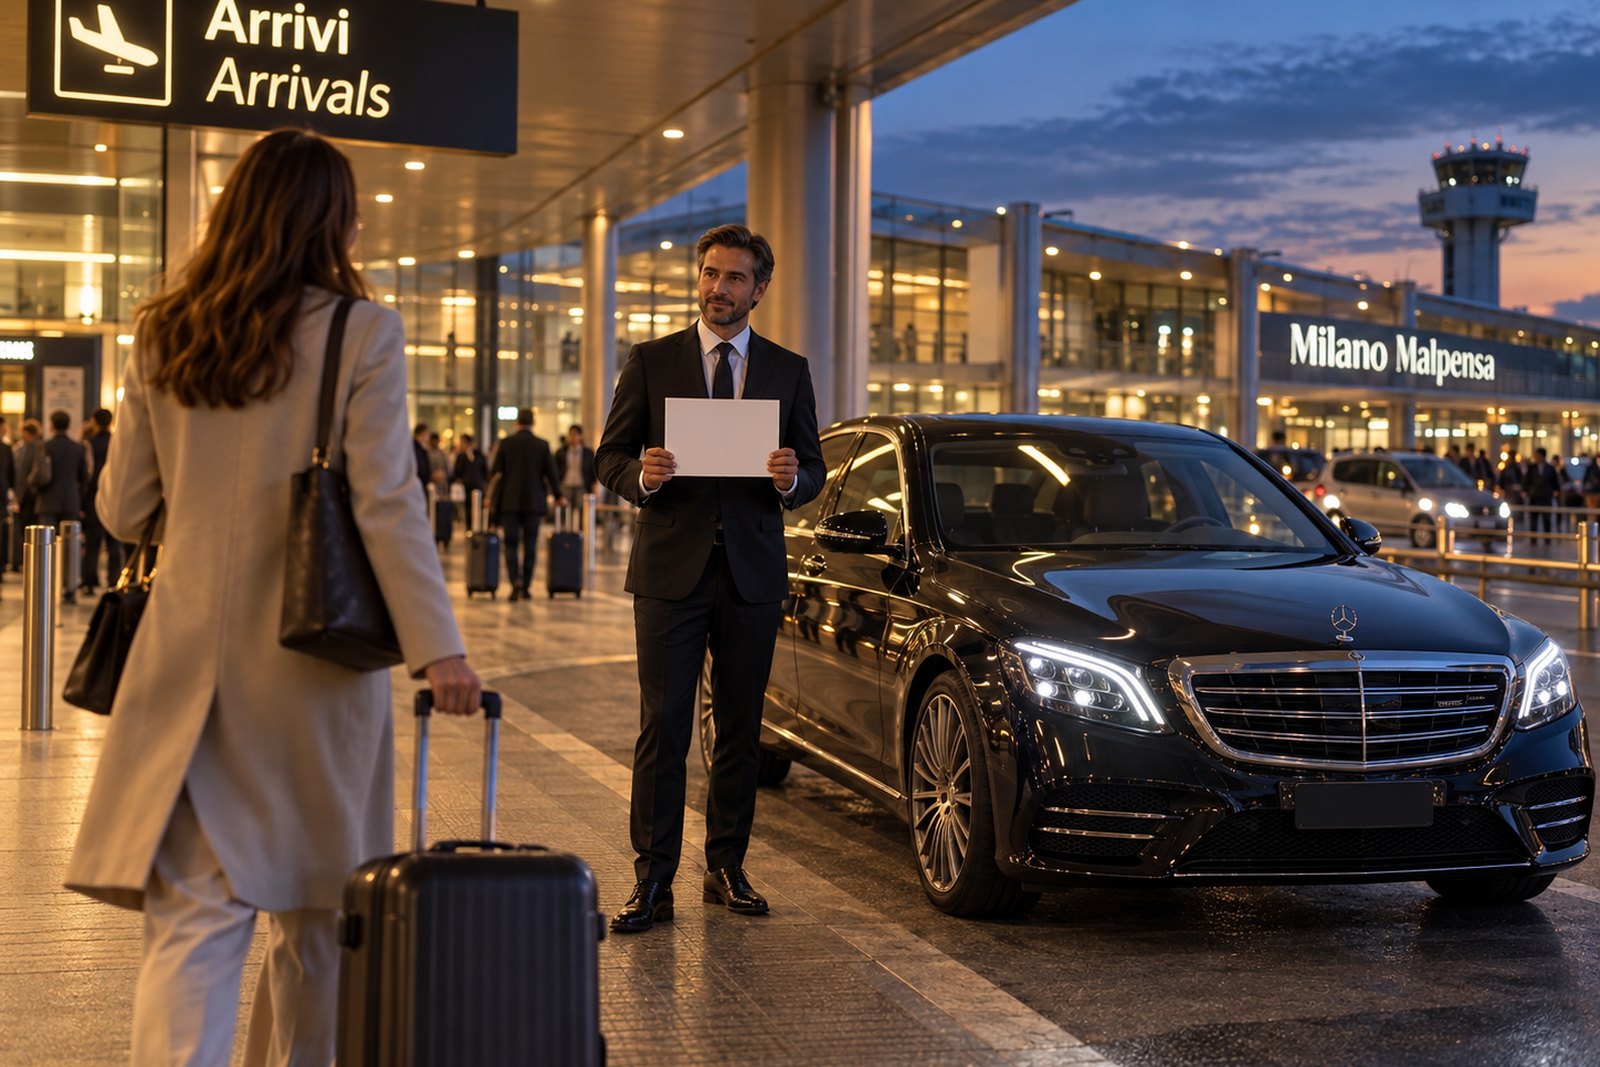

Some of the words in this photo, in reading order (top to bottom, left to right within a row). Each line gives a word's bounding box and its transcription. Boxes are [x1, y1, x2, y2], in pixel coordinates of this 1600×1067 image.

[205, 0, 349, 55] Arrivi
[206, 57, 391, 118] Arrivals
[1290, 323, 1388, 372] Milano
[1396, 334, 1495, 386] Malpensa
